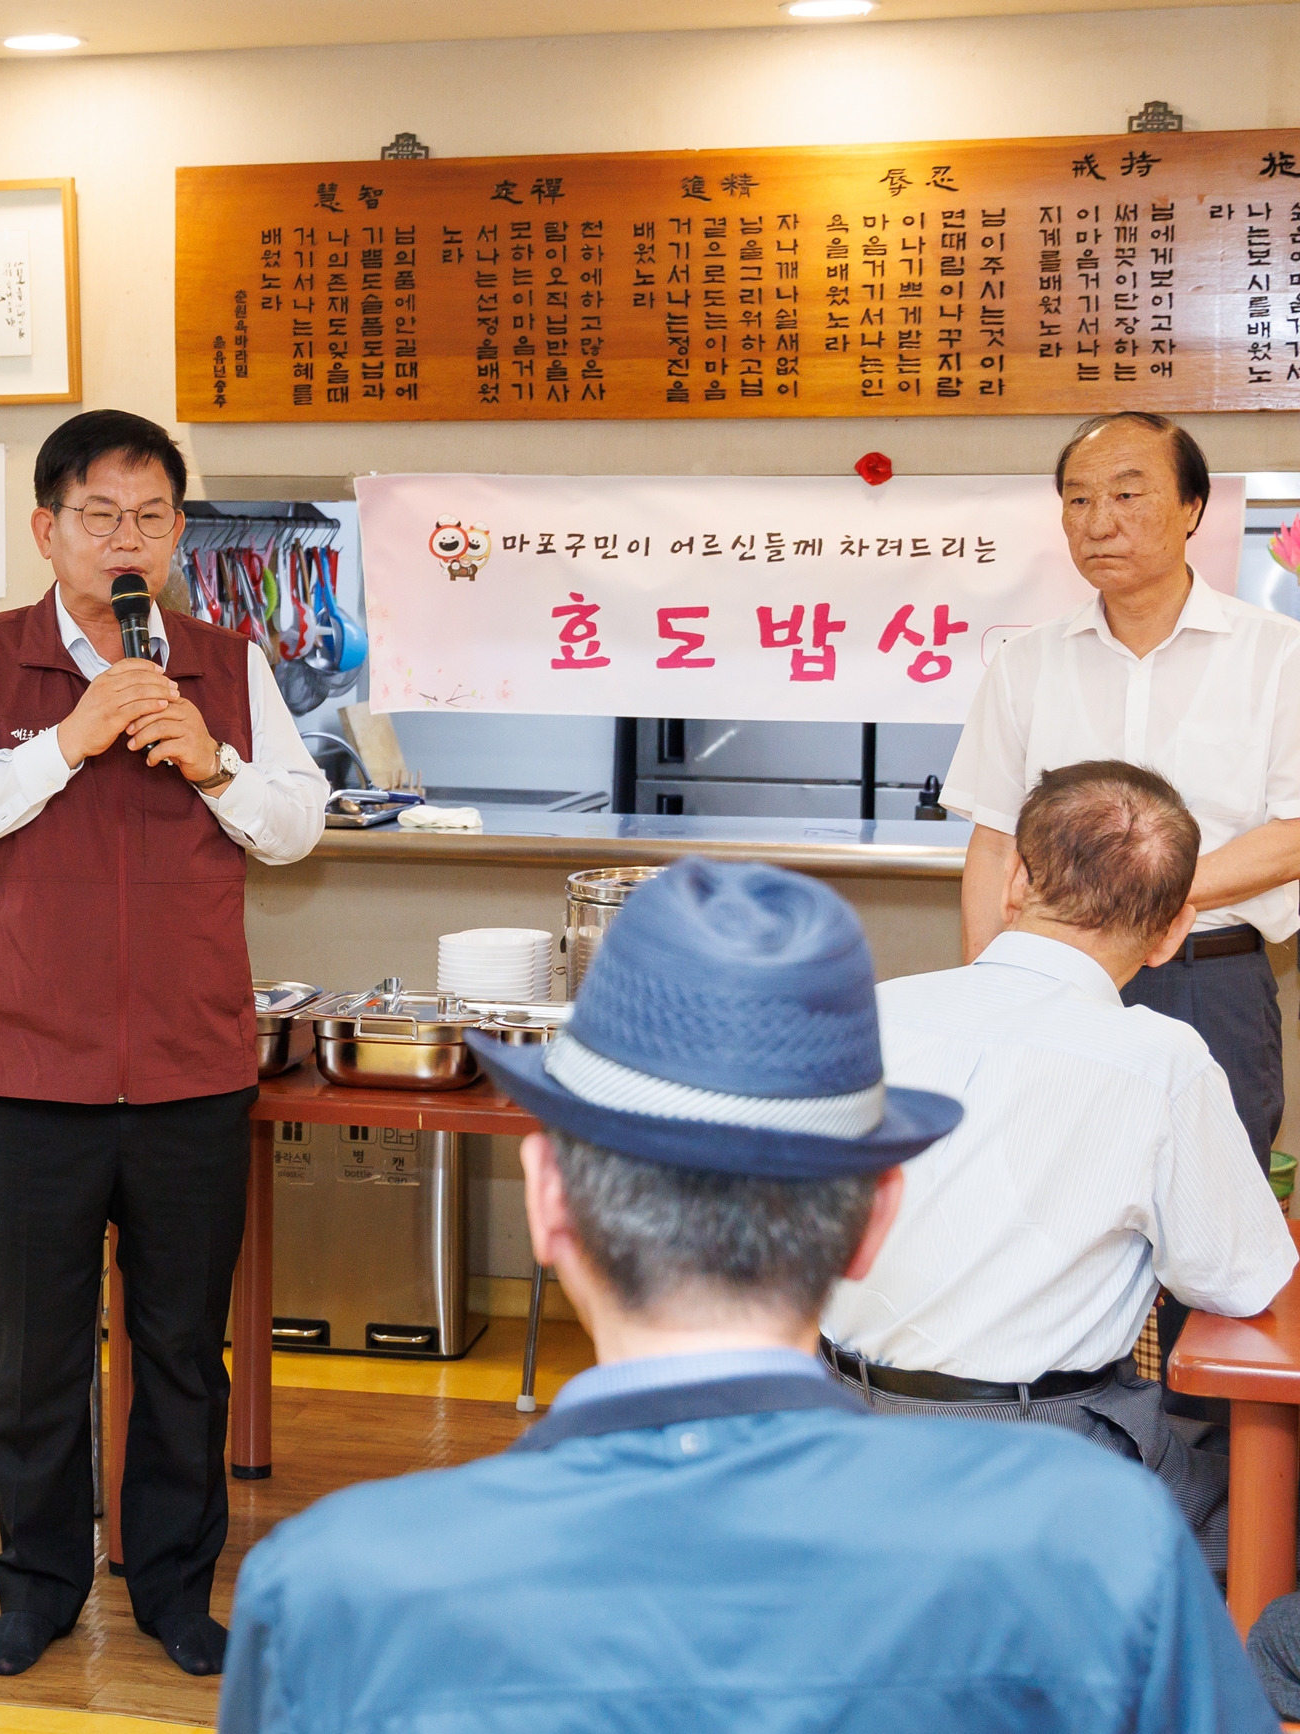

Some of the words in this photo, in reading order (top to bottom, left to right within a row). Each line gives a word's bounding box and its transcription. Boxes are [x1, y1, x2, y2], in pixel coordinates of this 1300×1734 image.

[502, 534, 652, 561] 마포구민이
[670, 533, 825, 564] 어르신들께
[840, 535, 998, 565] 차려드리는
[551, 592, 969, 683] 효도밥상
[353, 1150, 364, 1164] 병
[392, 1157, 405, 1172] 캔
[344, 1169, 372, 1178] bottle
